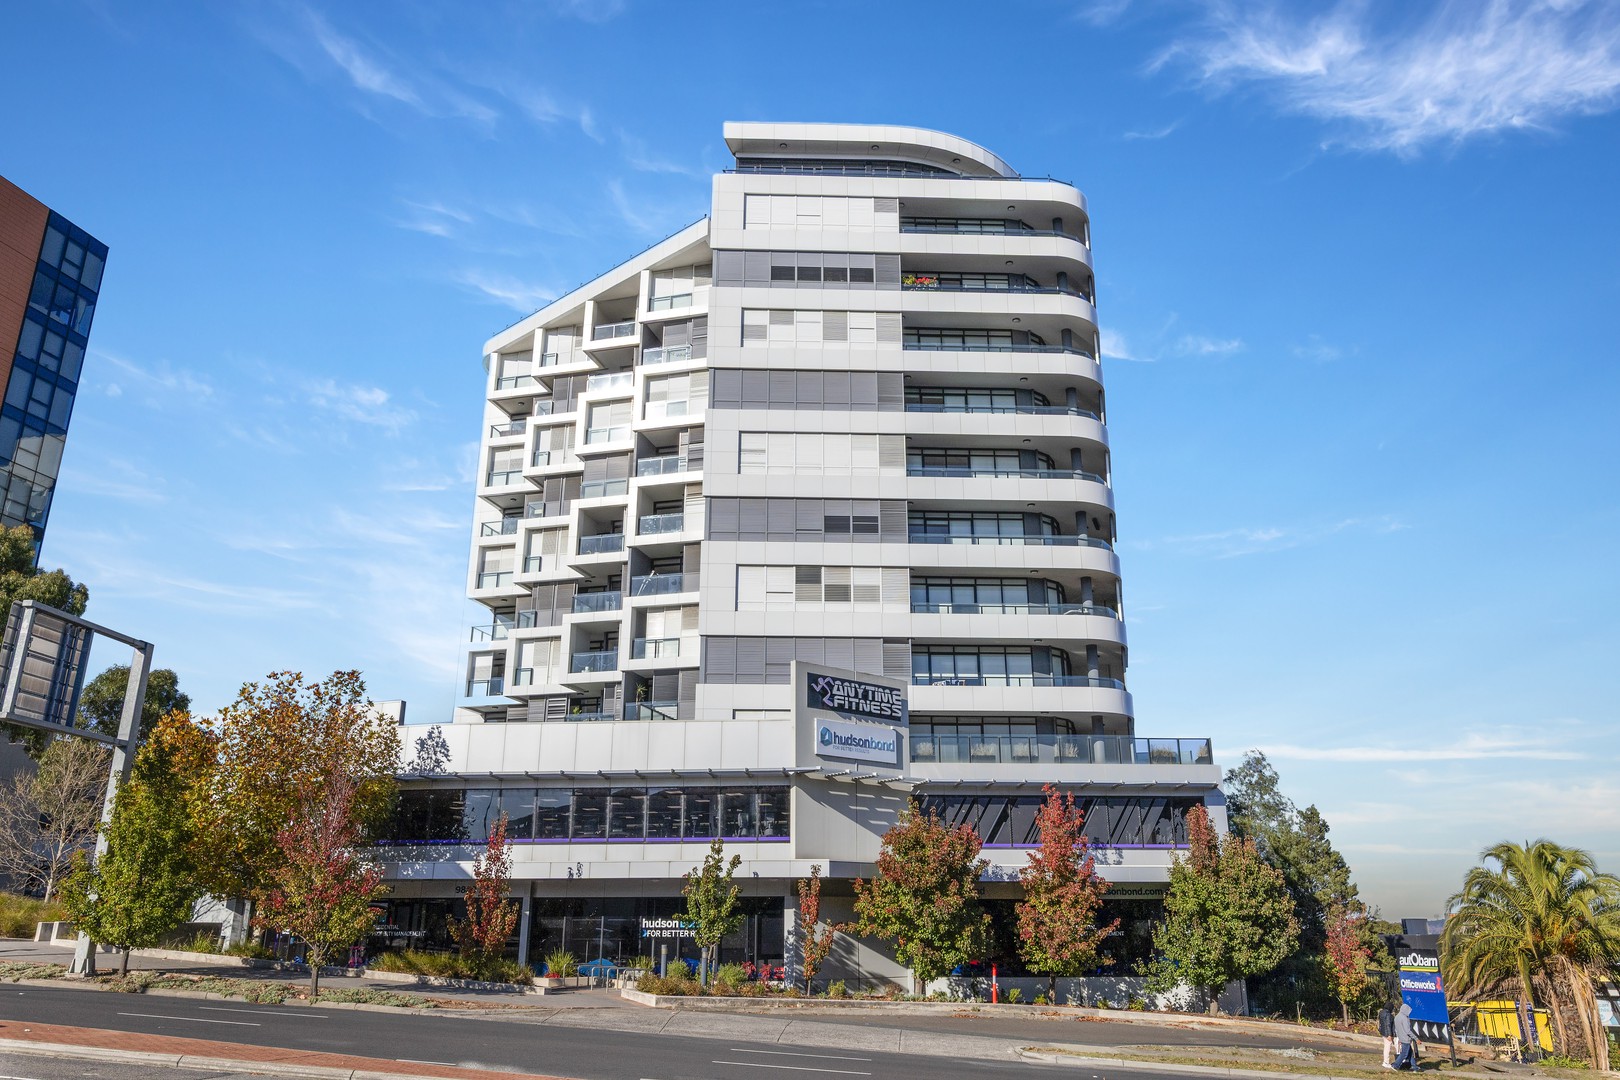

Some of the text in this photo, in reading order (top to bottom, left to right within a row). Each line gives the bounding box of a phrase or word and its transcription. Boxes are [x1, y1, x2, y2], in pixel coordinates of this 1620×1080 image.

[832, 681, 902, 705] ANYTIME
[833, 696, 902, 717] FITNESS
[833, 731, 895, 752] hudsonbond
[647, 929, 661, 938] FOR
[662, 929, 690, 938] BETTER
[1401, 979, 1435, 990] Officeworks
